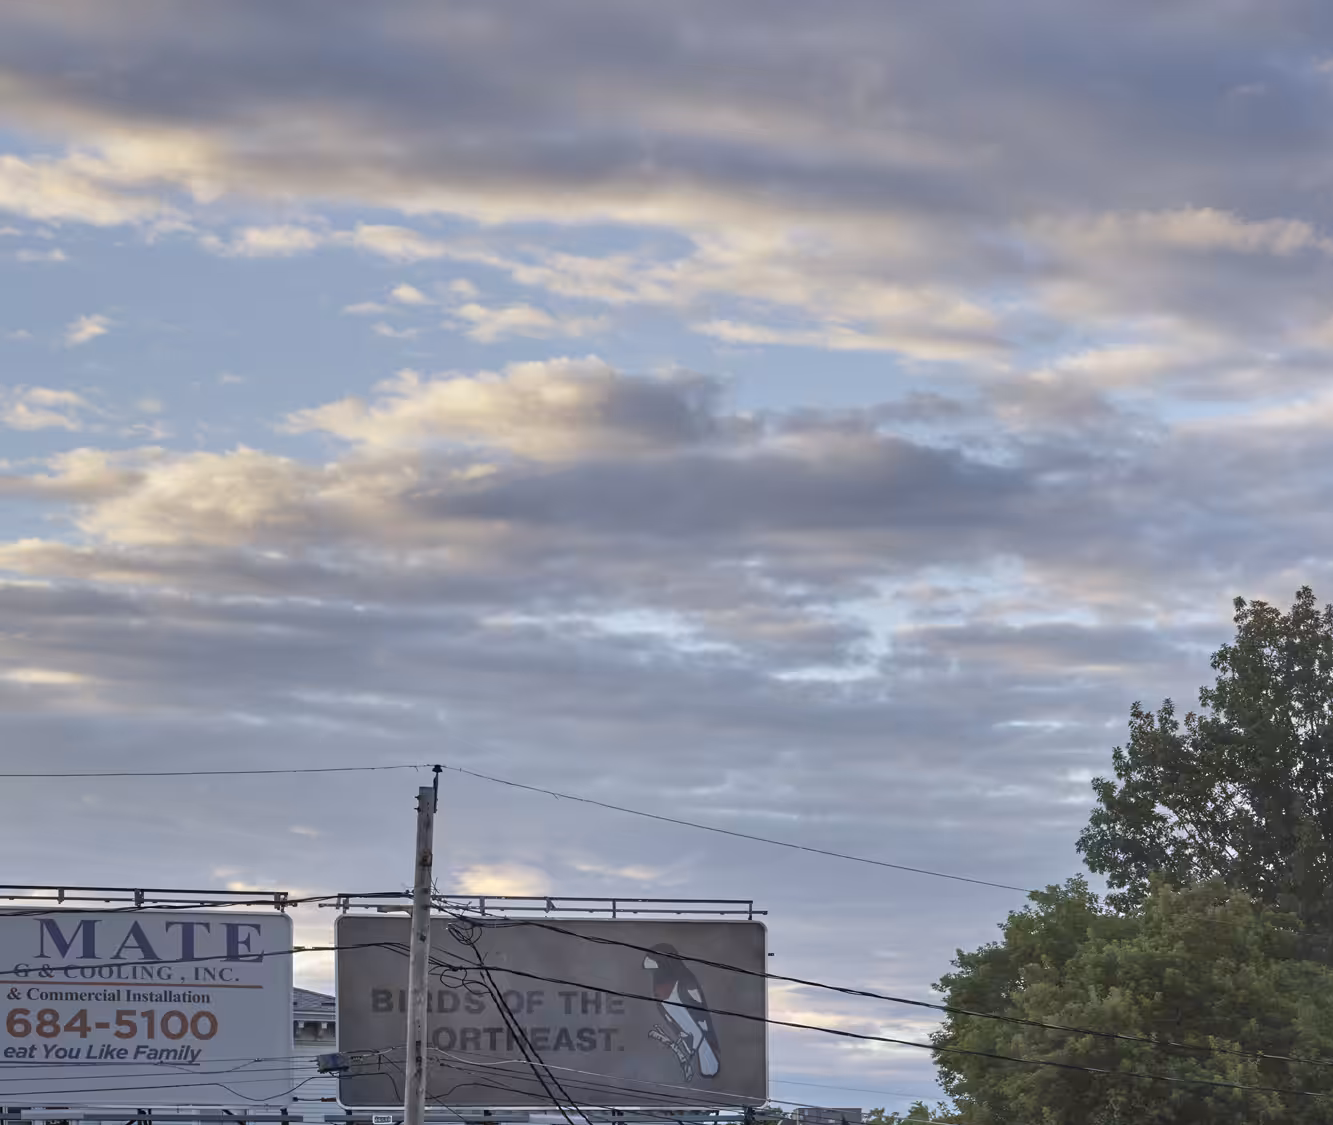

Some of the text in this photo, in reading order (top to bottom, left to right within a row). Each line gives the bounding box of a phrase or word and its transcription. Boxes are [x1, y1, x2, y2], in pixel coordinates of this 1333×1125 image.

[33, 918, 264, 962] MATE
[194, 967, 240, 982] INC.
[7, 987, 210, 1003] & Commercial Installation
[371, 989, 625, 1015] BIDS OF THE
[6, 1007, 218, 1040] 684-5100
[432, 1026, 625, 1052] ORTHEAST.
[4, 1044, 202, 1063] eat You Like Family
